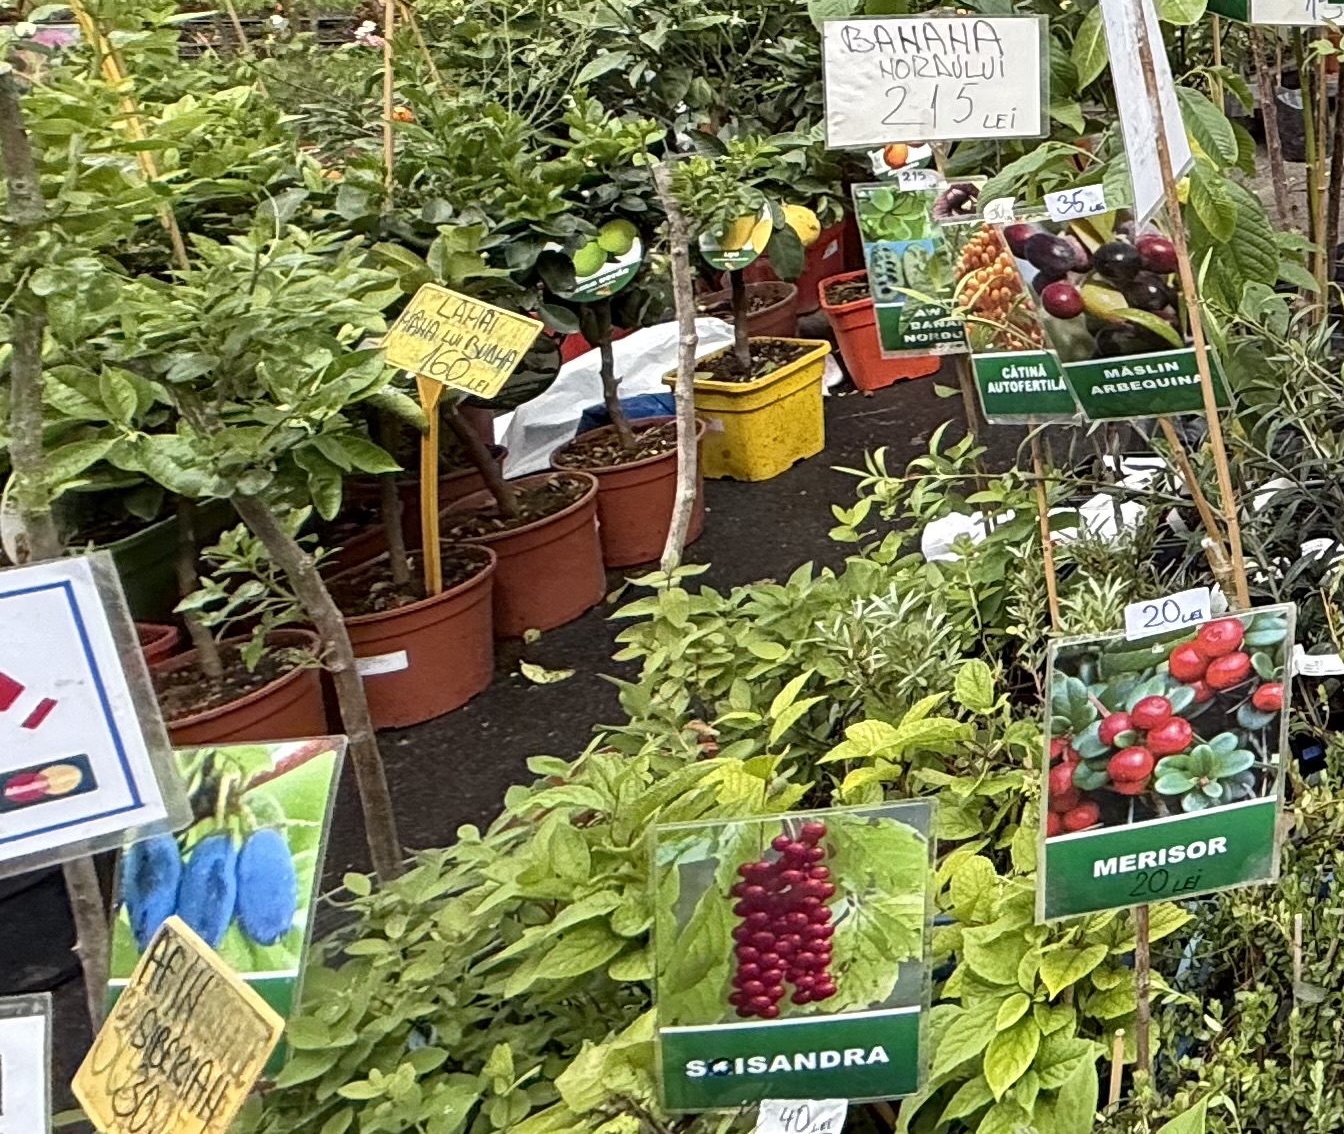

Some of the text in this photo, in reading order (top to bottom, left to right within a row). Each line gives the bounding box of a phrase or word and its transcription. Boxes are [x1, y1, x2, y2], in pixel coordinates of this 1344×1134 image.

[840, 20, 1004, 56] BANANA
[904, 331, 964, 343] NORDU
[987, 376, 1067, 394] AUTOFERTILĂ
[1142, 599, 1182, 629] 20
[1092, 836, 1228, 878] MERISOR
[685, 1044, 890, 1079] SISANDRA
